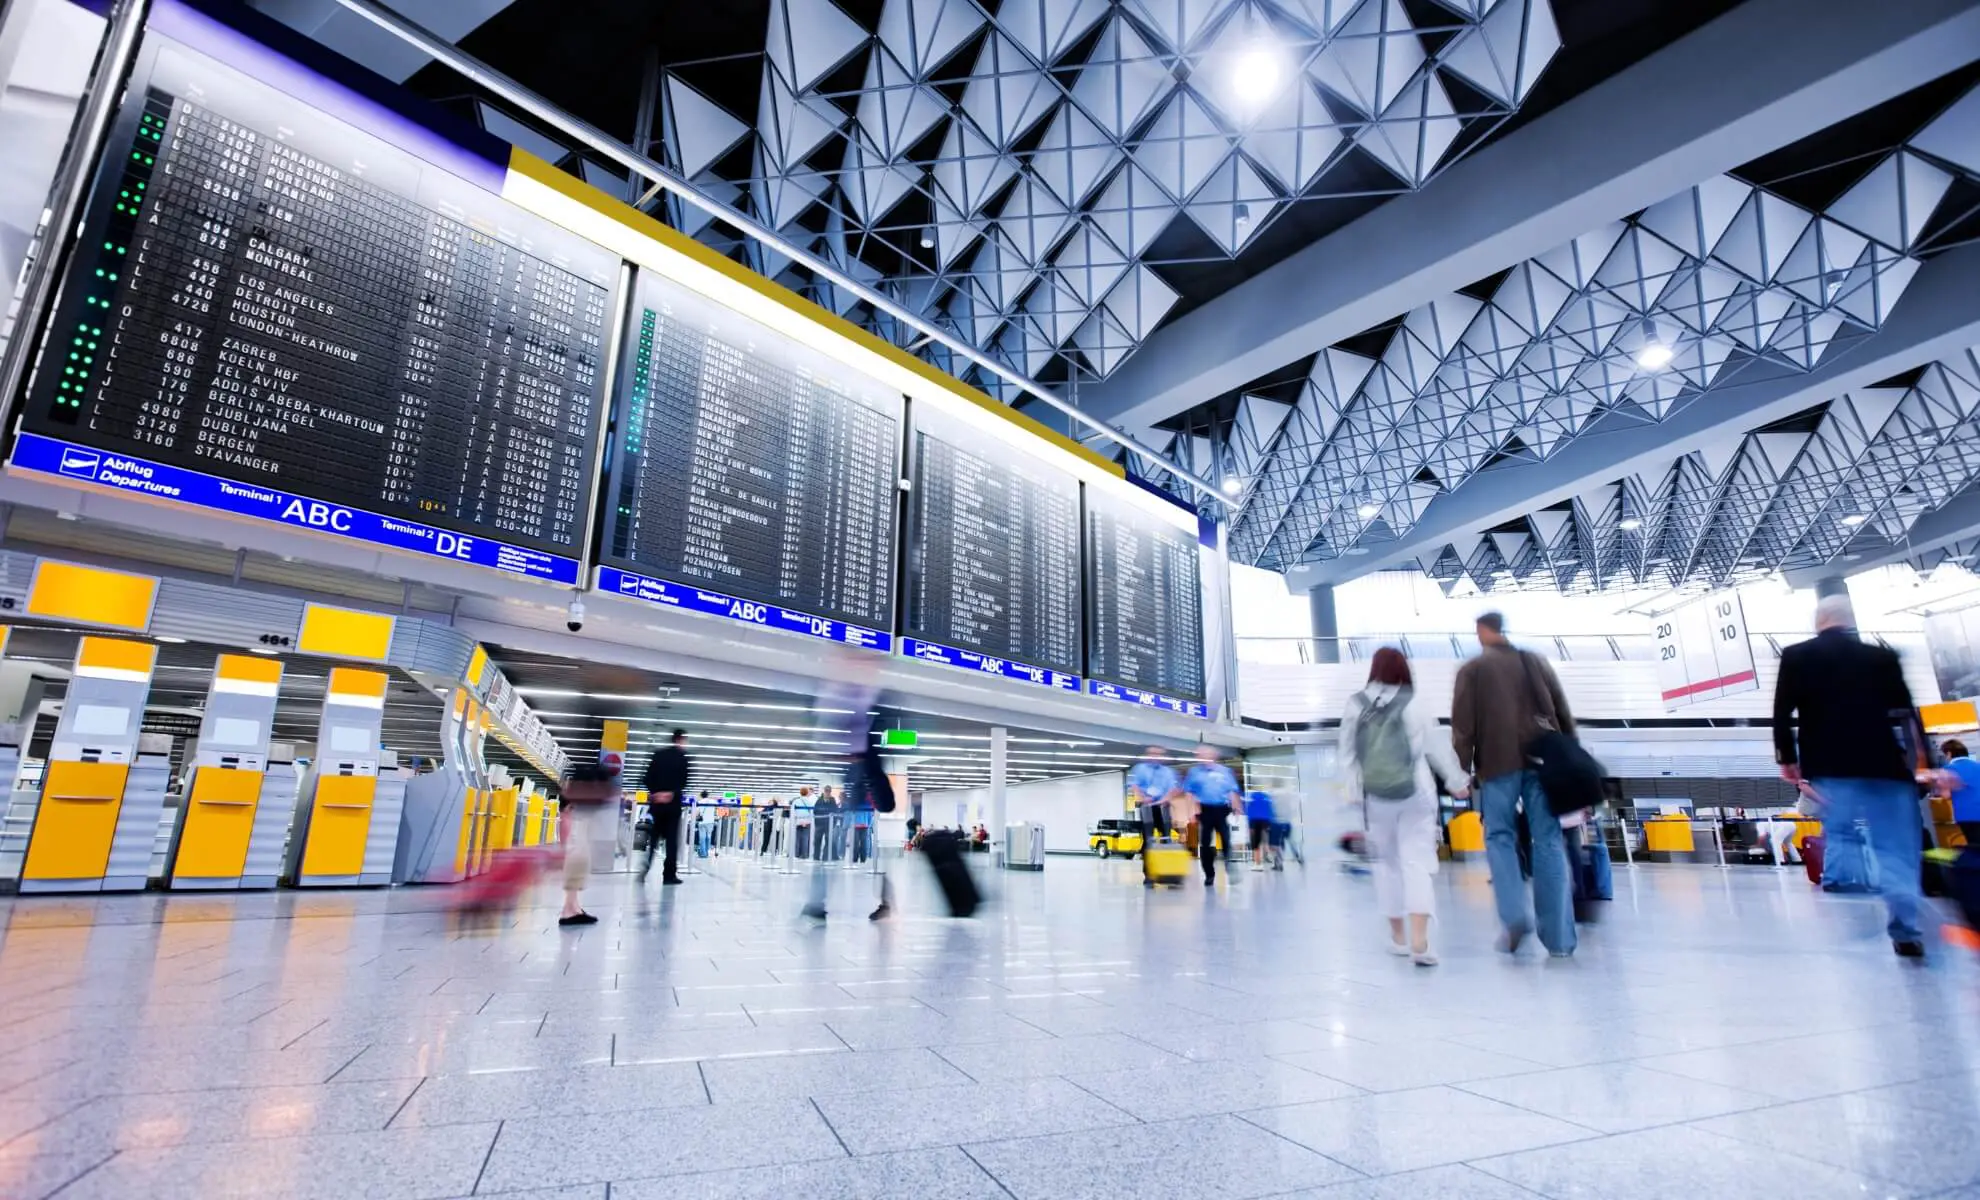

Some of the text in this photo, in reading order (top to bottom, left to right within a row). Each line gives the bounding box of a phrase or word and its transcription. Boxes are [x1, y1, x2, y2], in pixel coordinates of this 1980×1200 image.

[171, 138, 181, 150] L
[264, 178, 307, 203] MIAMI
[175, 127, 333, 202] L PORTLAND
[178, 115, 336, 191] L 3102 HELSINKI
[273, 144, 338, 180] VARADERO
[164, 163, 174, 174] L
[258, 201, 293, 223] IEW
[149, 212, 159, 224] A
[199, 231, 228, 249] 875
[245, 249, 314, 282] MONTREAL
[153, 199, 163, 211] L
[202, 218, 231, 237] 494
[248, 237, 309, 268] CALGARY
[134, 264, 144, 276] L
[185, 281, 214, 299] 440
[232, 298, 295, 328] HOUSTON
[138, 251, 148, 262] L
[188, 268, 218, 287] 442
[235, 286, 298, 316] DETROIT
[142, 238, 152, 249] L
[239, 273, 266, 291] LOS
[274, 286, 333, 315] ANGELES
[130, 277, 140, 289] L
[229, 311, 358, 362] LONDON-HEATHROW
[174, 320, 204, 338] 417
[222, 337, 277, 363] ZAGREB
[118, 318, 128, 329] L
[160, 331, 200, 352] 6808
[218, 350, 265, 373] KOELN
[273, 366, 300, 383] HBF
[105, 359, 116, 372] L
[158, 375, 189, 392] 176
[208, 389, 317, 429] BERLIN-TEGEL
[558, 488, 577, 501] A13
[110, 345, 120, 357] L
[162, 361, 193, 379] 590
[211, 376, 259, 399] ADDIS
[266, 392, 385, 435] ABEBA-KHARTOUM
[560, 477, 578, 490] B23
[114, 331, 124, 343] L
[215, 363, 244, 380] TEL
[252, 374, 289, 393] AVIV
[561, 466, 580, 479] B20
[92, 403, 103, 415] L
[136, 414, 178, 434] 3126
[197, 430, 255, 454] BERGEN
[553, 522, 566, 533] B1
[97, 388, 107, 400] L
[140, 400, 182, 420] 4980
[201, 416, 258, 441] DUBLIN
[555, 510, 574, 524] B32
[101, 374, 111, 386] J
[154, 388, 185, 406] 117
[204, 403, 288, 435] LJUBLJANA
[557, 499, 575, 512] B11
[103, 457, 153, 478] Abflug
[695, 445, 724, 463] DALLAS
[88, 417, 98, 430] L
[131, 429, 174, 449] 3160
[193, 444, 279, 474] STAVANGER
[552, 533, 571, 546] B13
[99, 470, 181, 496] Departures
[219, 482, 353, 532] Terminal 1 ABC
[381, 519, 473, 559] Terminal 2 DE
[0, 596, 14, 609] 5
[697, 591, 767, 623] Terminal ABC
[811, 617, 832, 638] DE
[1715, 601, 1731, 618] 10
[259, 633, 289, 646] 464
[1657, 622, 1672, 639] 20
[1661, 644, 1676, 661] 20
[1720, 624, 1736, 641] 10
[980, 659, 1004, 675] ABC
[1030, 667, 1044, 683] DE
[1139, 692, 1155, 706] ABC
